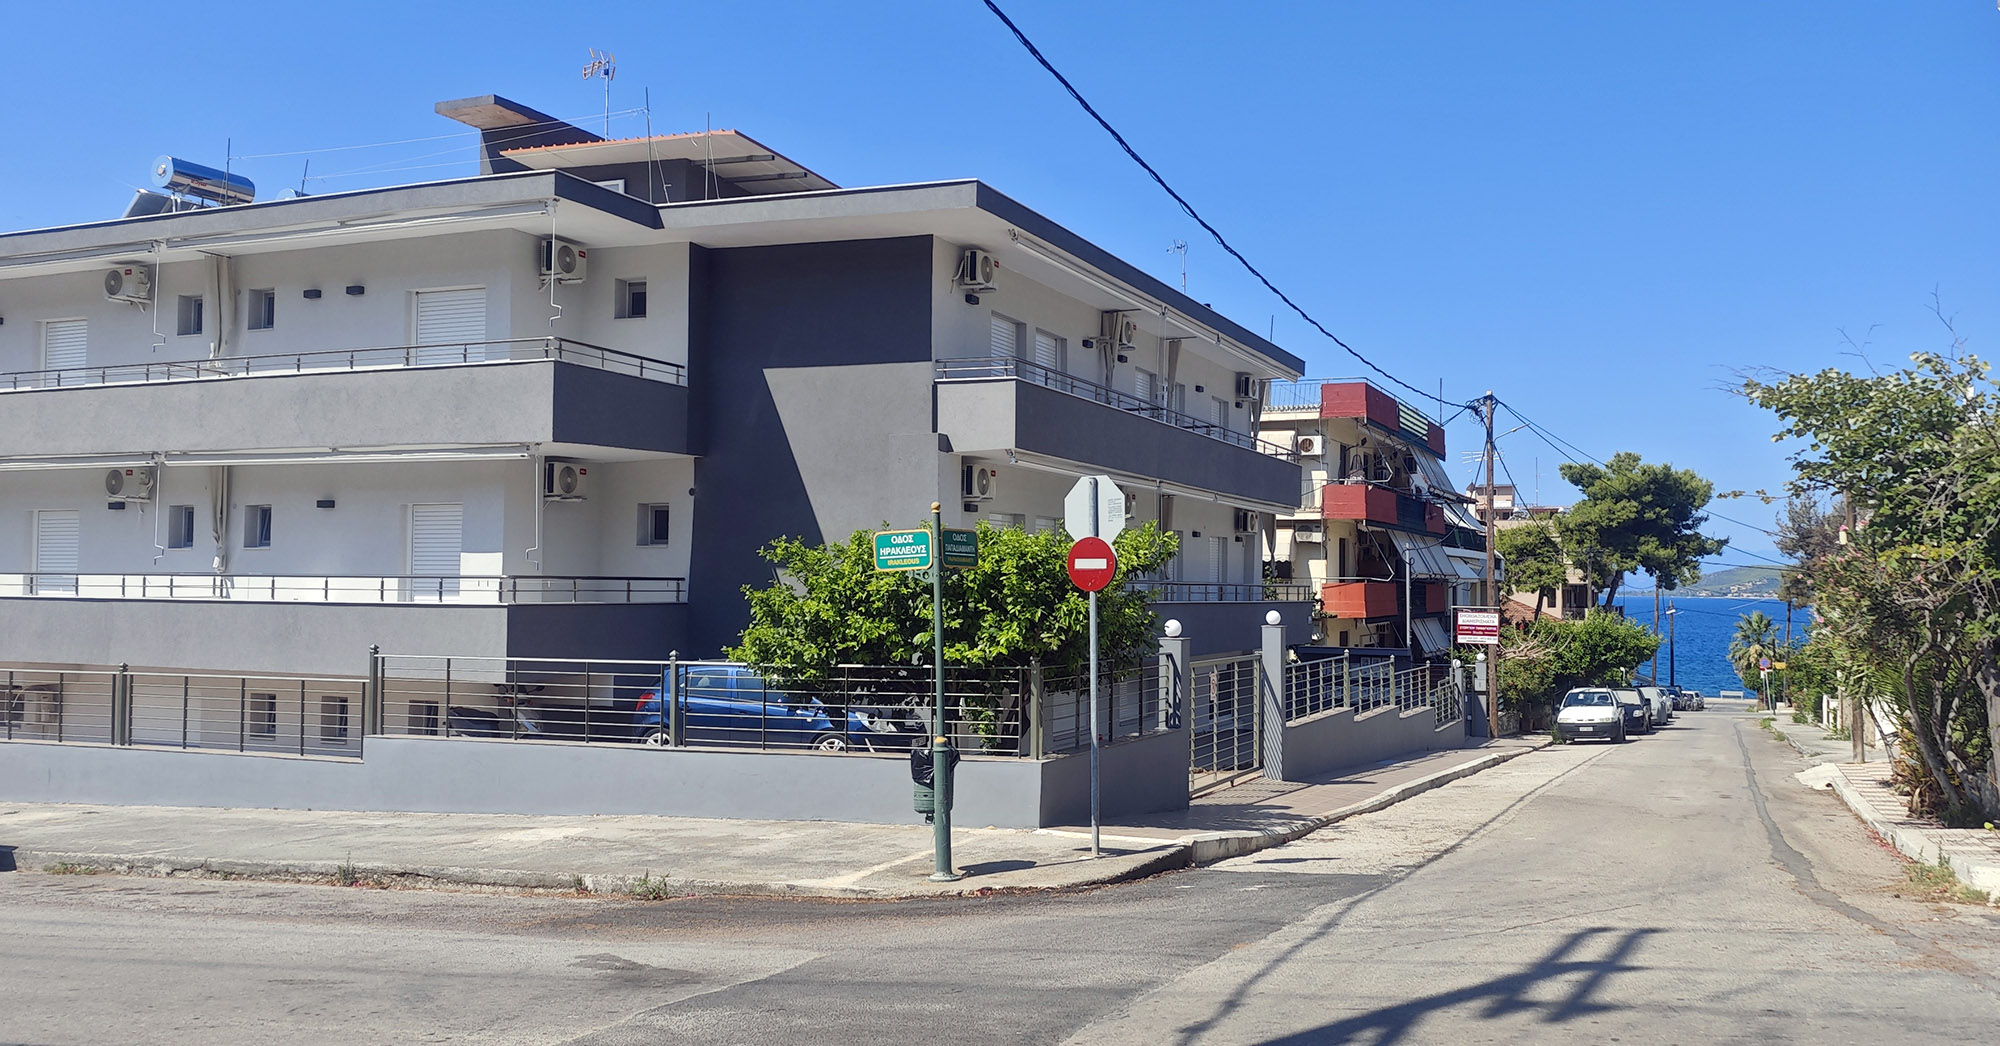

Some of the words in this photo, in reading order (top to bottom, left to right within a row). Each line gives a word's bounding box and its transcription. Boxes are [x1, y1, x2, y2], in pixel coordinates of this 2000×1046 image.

[891, 535, 914, 544] ΟΔΟΣ
[952, 533, 967, 542] ΟΔΟΣ
[880, 544, 927, 556] ΗΡΑΚΛΕΟΥΣ
